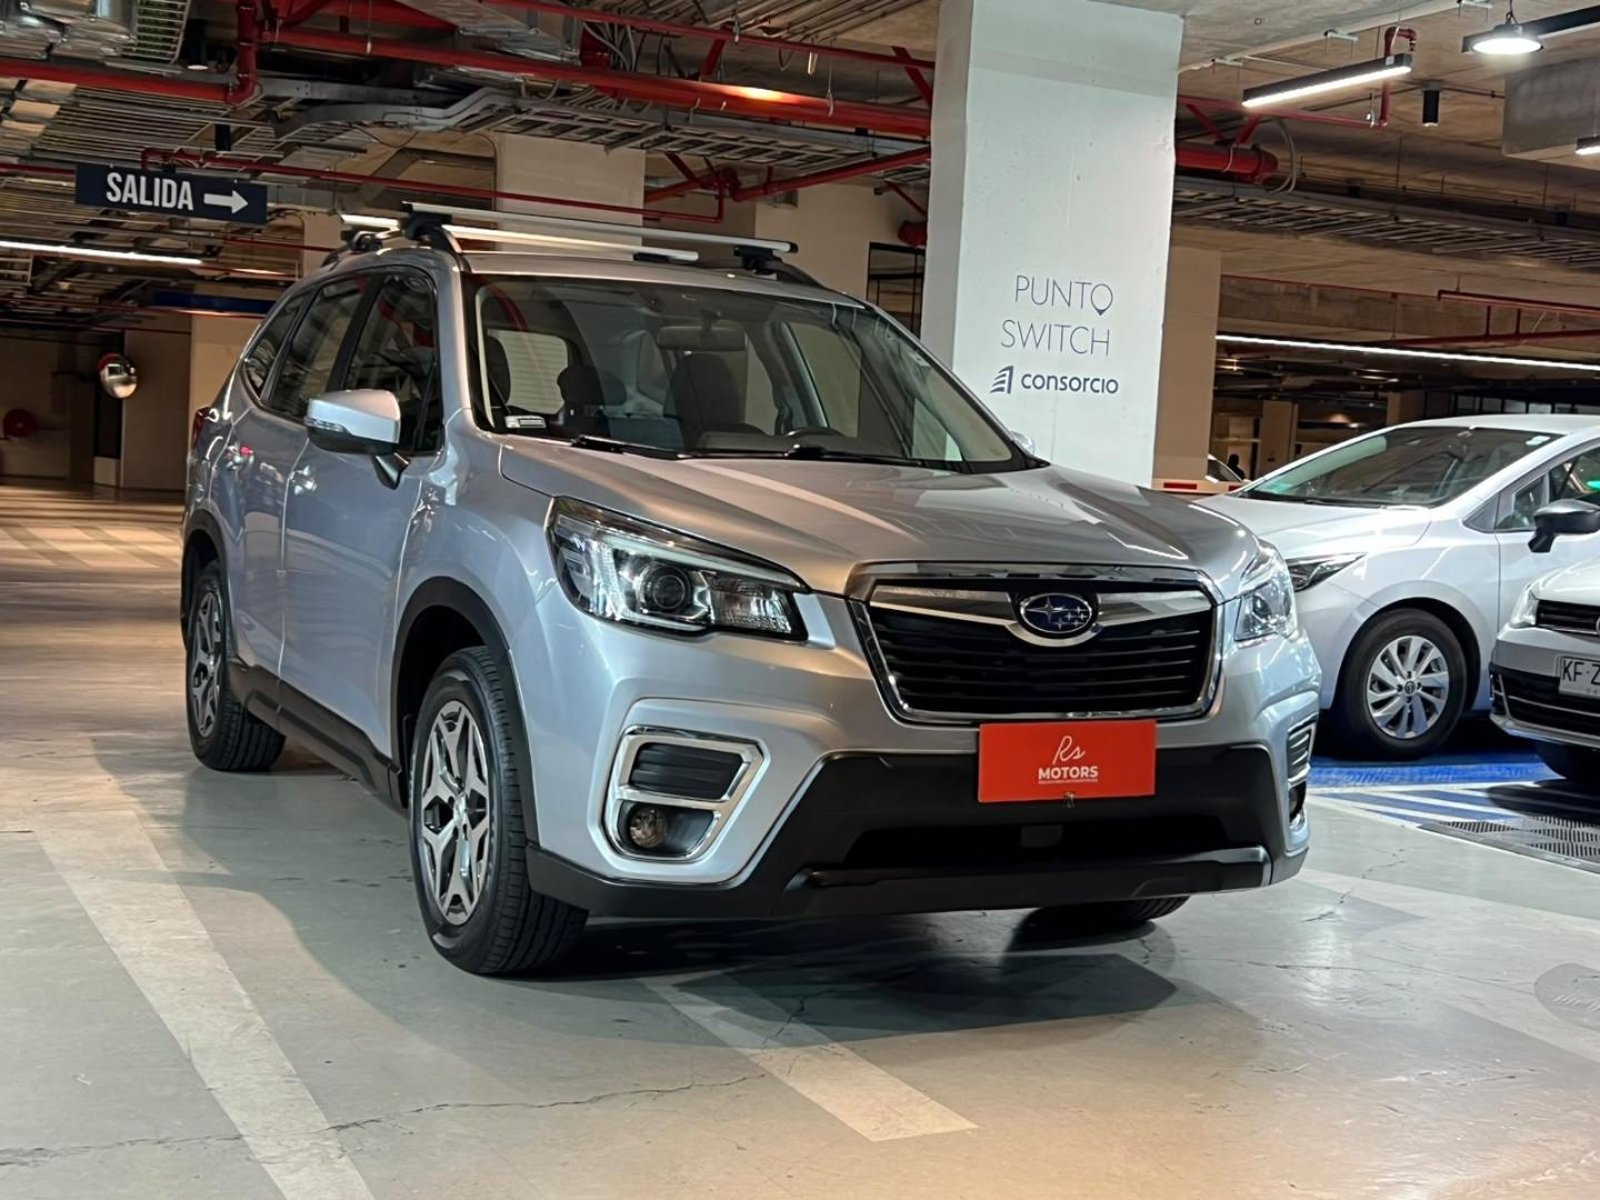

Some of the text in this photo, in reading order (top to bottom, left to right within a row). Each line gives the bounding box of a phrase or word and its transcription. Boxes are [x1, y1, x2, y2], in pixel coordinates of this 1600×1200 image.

[106, 172, 194, 211] SALIDA
[1015, 275, 1114, 316] PUNTO
[1000, 319, 1110, 356] SWITCH
[1021, 373, 1119, 394] consorcio
[1038, 766, 1098, 780] MOTORS
